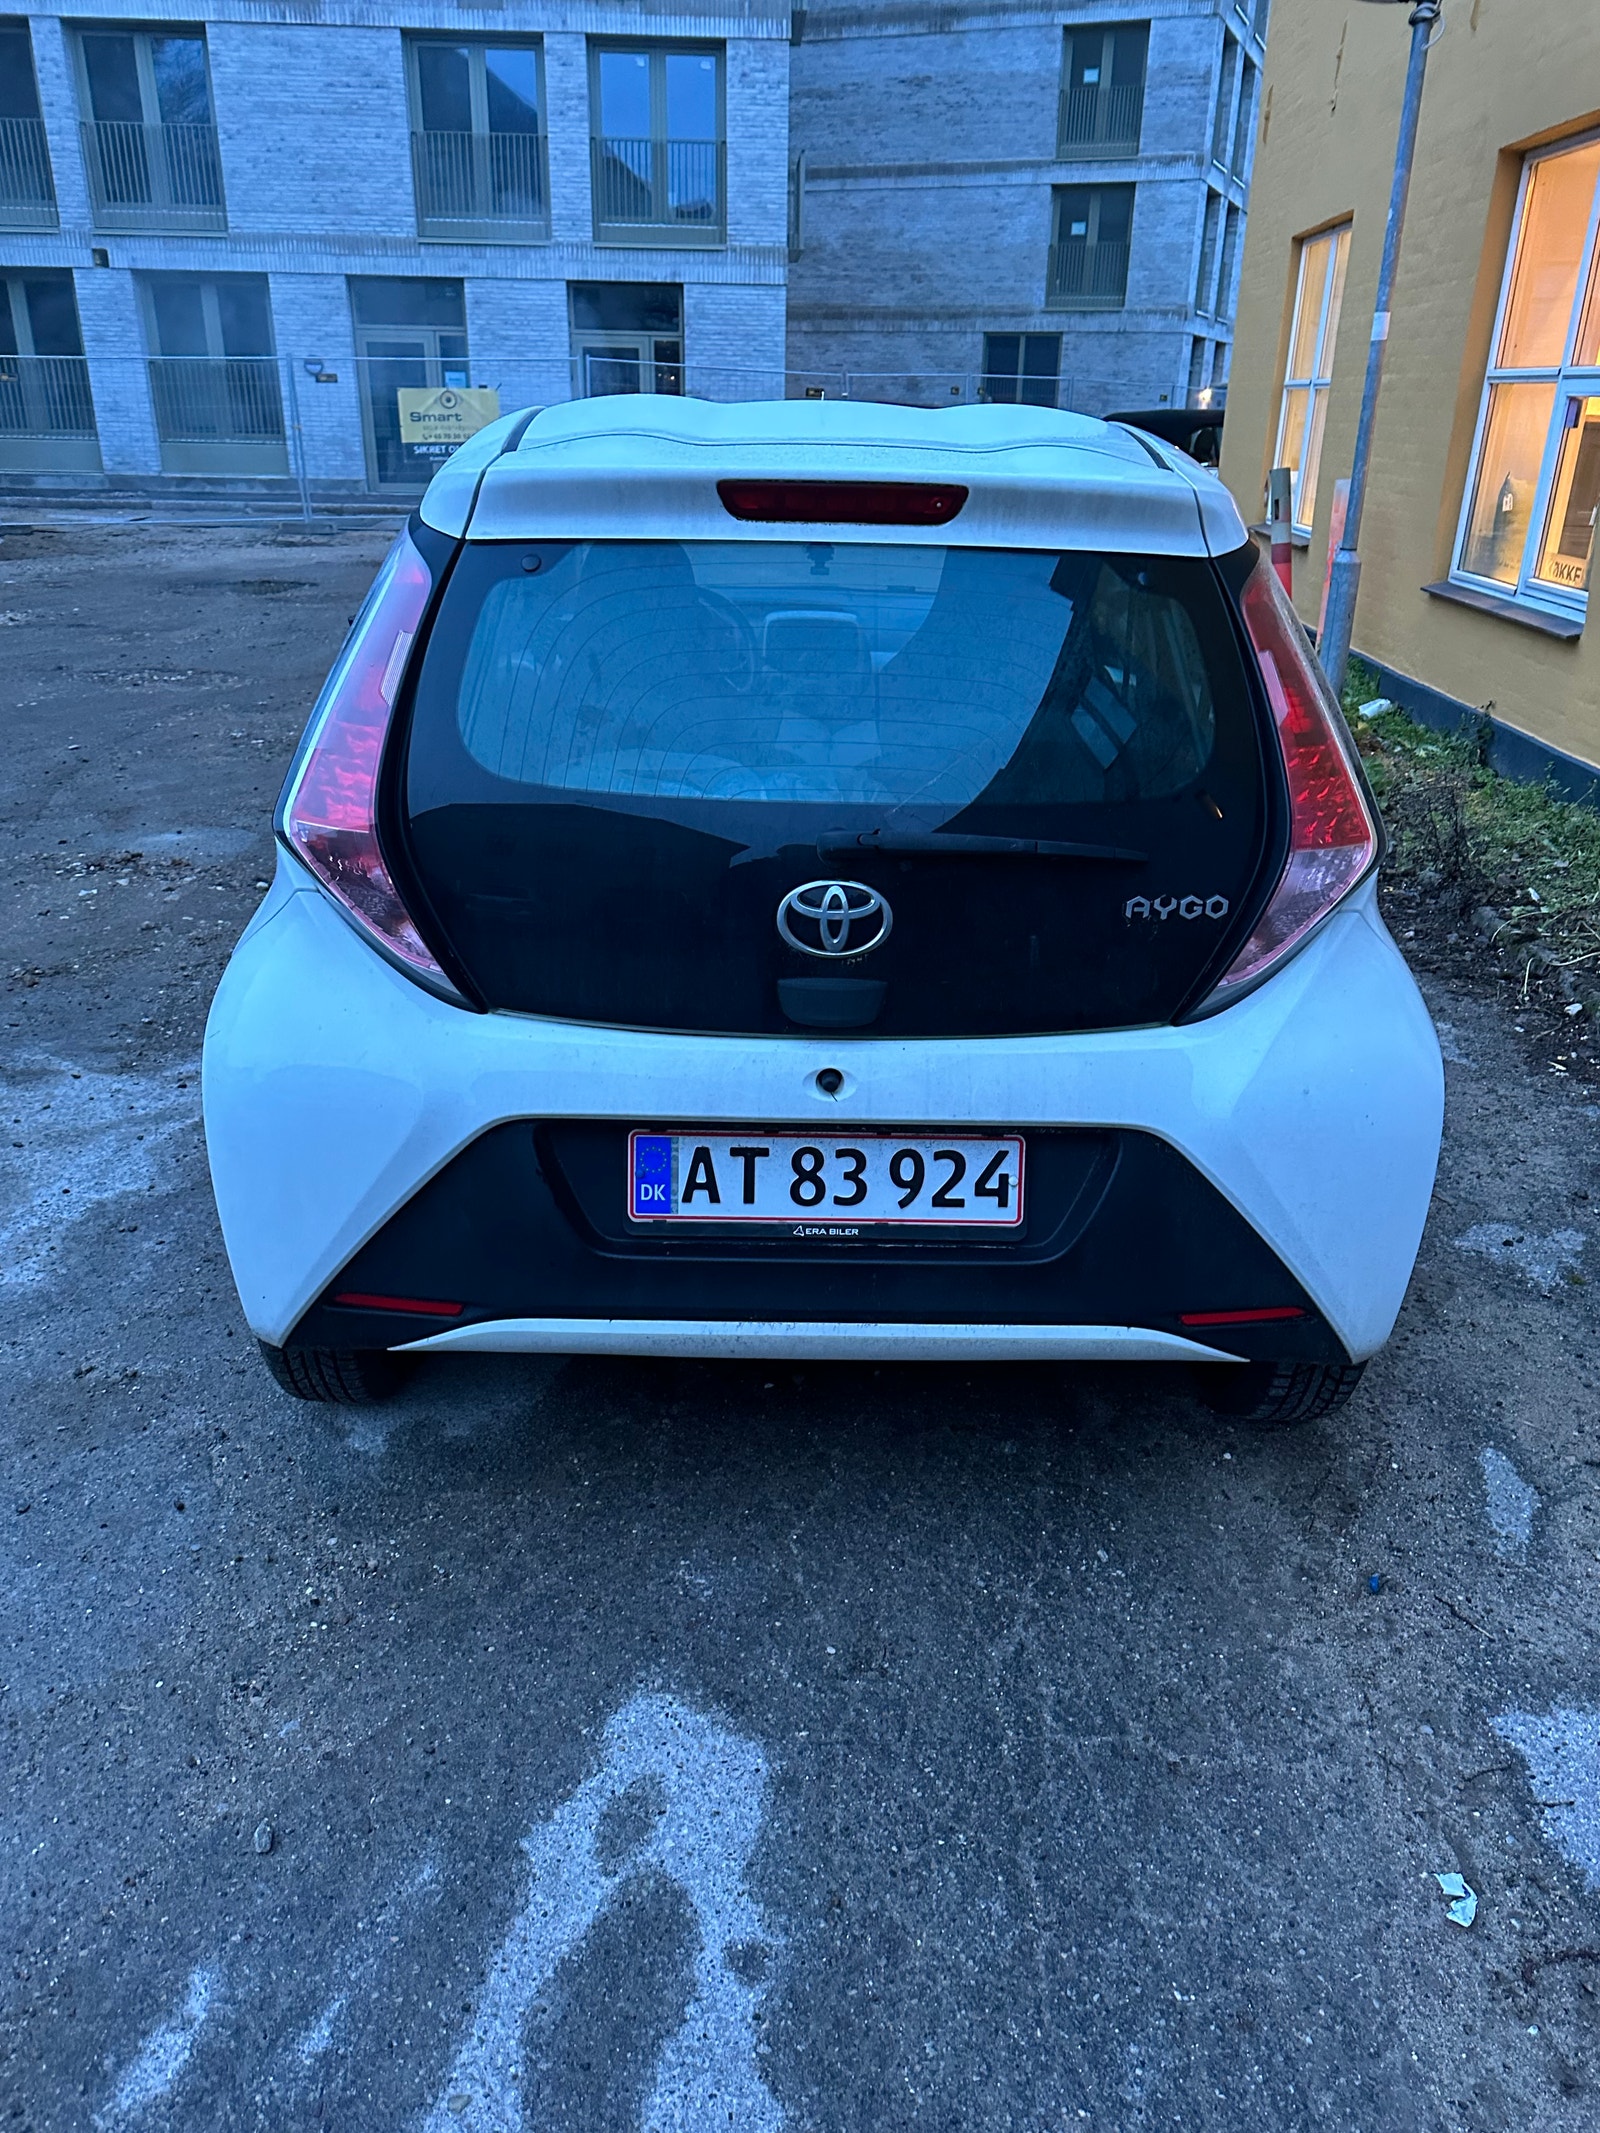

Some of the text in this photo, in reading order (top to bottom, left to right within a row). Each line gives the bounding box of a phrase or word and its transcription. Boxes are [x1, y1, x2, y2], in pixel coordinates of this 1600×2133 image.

[410, 411, 463, 422] Smart
[413, 444, 446, 454] SIKRET
[1125, 895, 1229, 920] AYGO
[681, 1146, 1010, 1209] AT 83 924
[640, 1183, 666, 1201] DK
[829, 1228, 859, 1236] BILER
